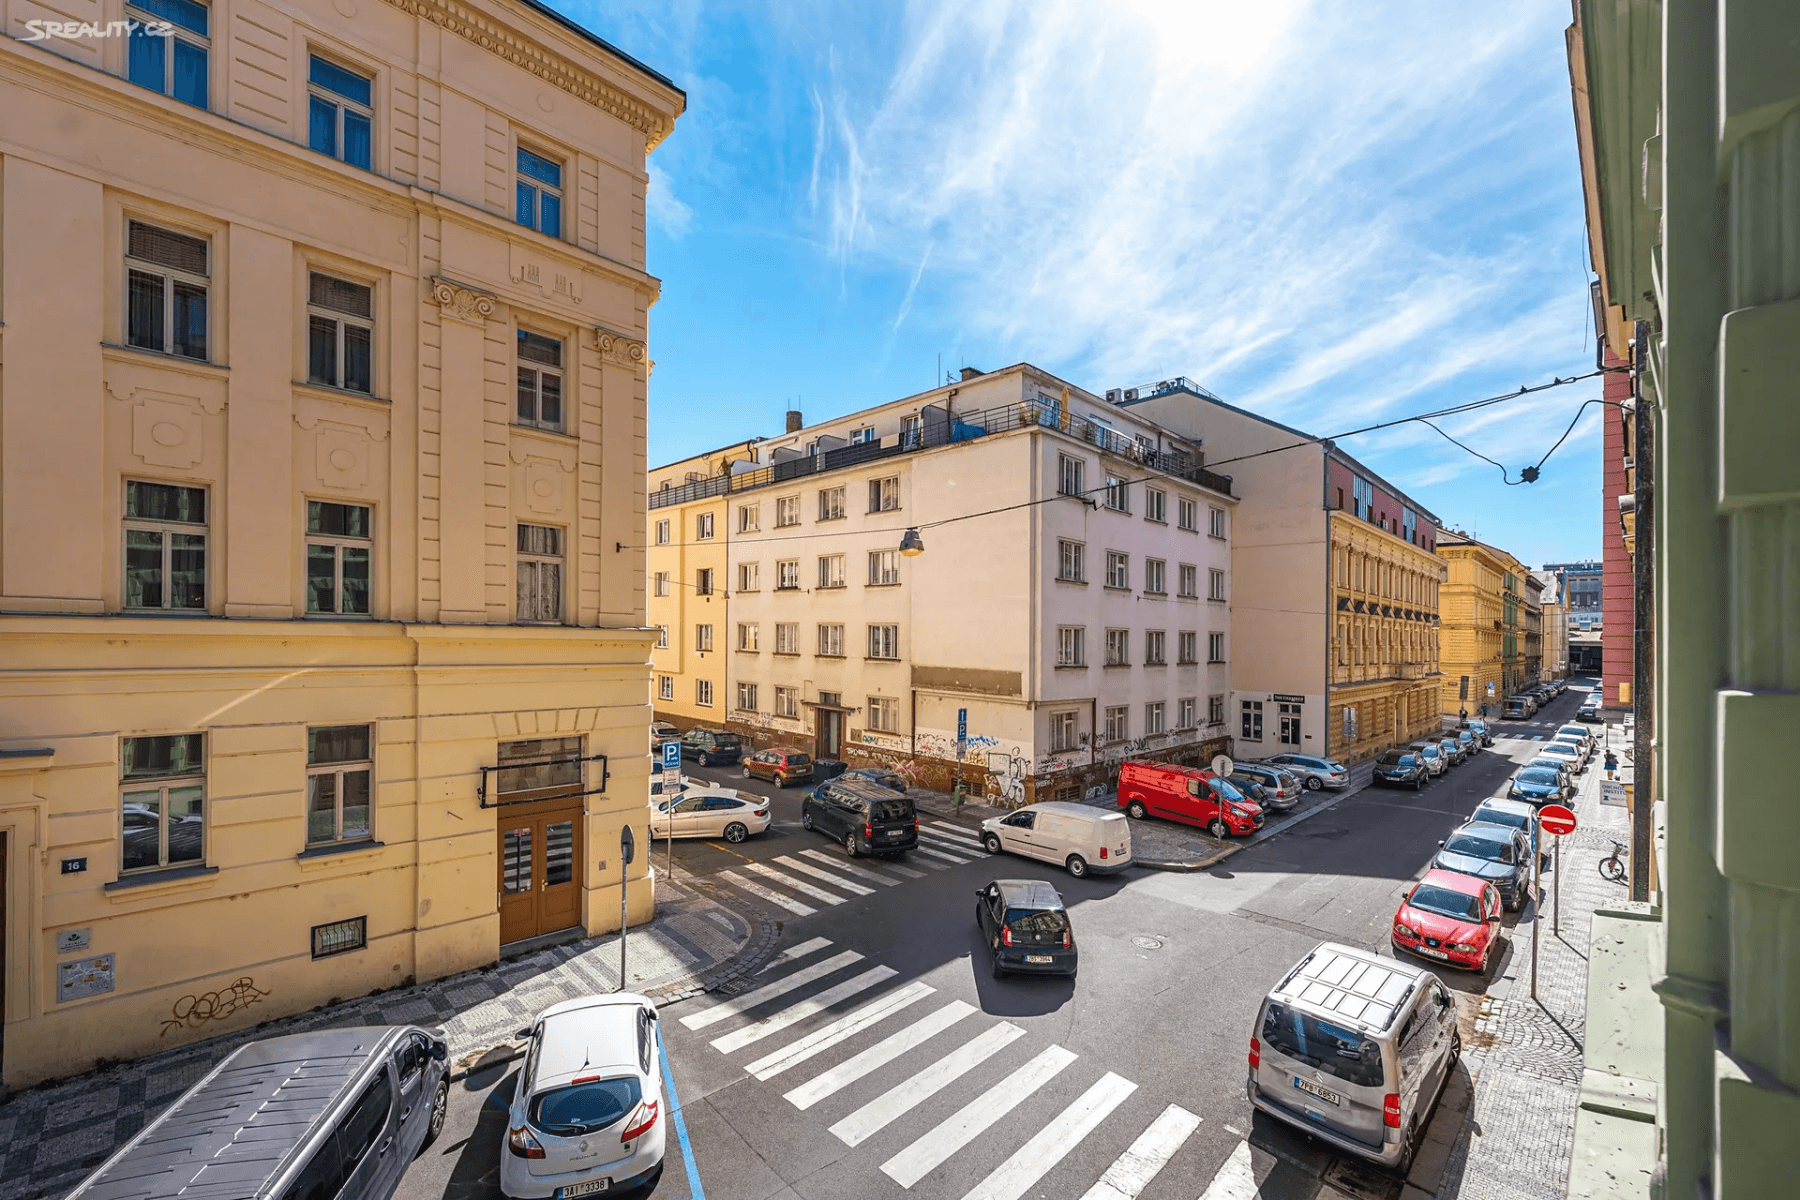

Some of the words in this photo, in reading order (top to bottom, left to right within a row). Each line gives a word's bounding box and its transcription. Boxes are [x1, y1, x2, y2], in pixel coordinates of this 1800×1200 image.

[666, 745, 677, 761] P
[67, 861, 80, 871] 16
[585, 1180, 605, 1192] 3338
